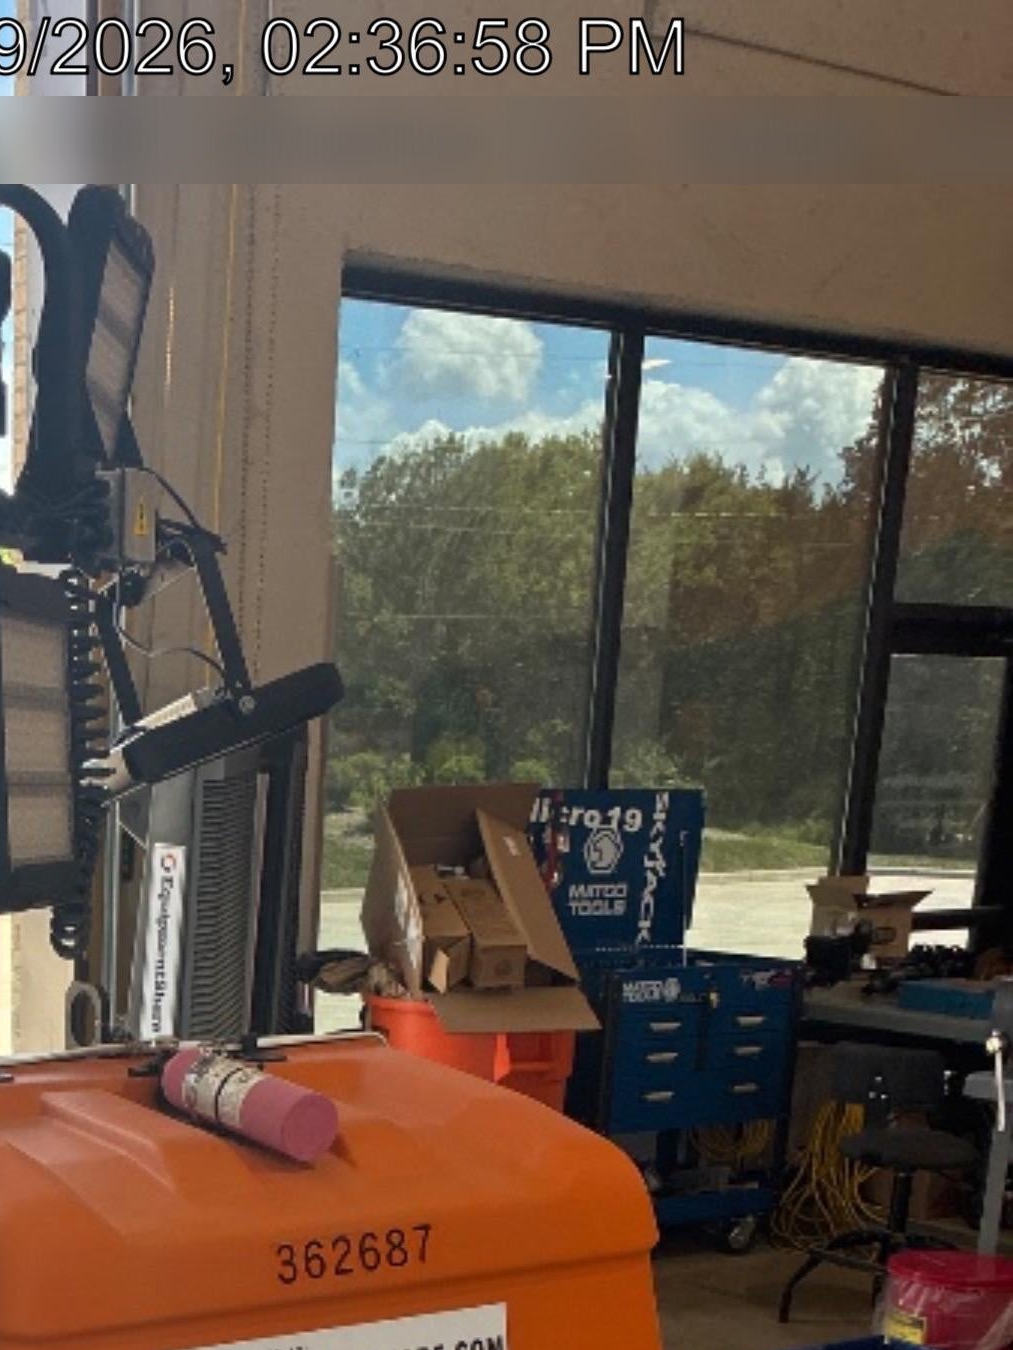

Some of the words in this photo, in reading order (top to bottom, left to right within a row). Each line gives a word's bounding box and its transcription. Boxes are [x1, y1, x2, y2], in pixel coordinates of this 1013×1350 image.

[635, 791, 670, 946] SKYJACK
[568, 883, 627, 899] MATCO
[568, 899, 627, 916] TOOLS
[275, 1223, 433, 1286] 362687
